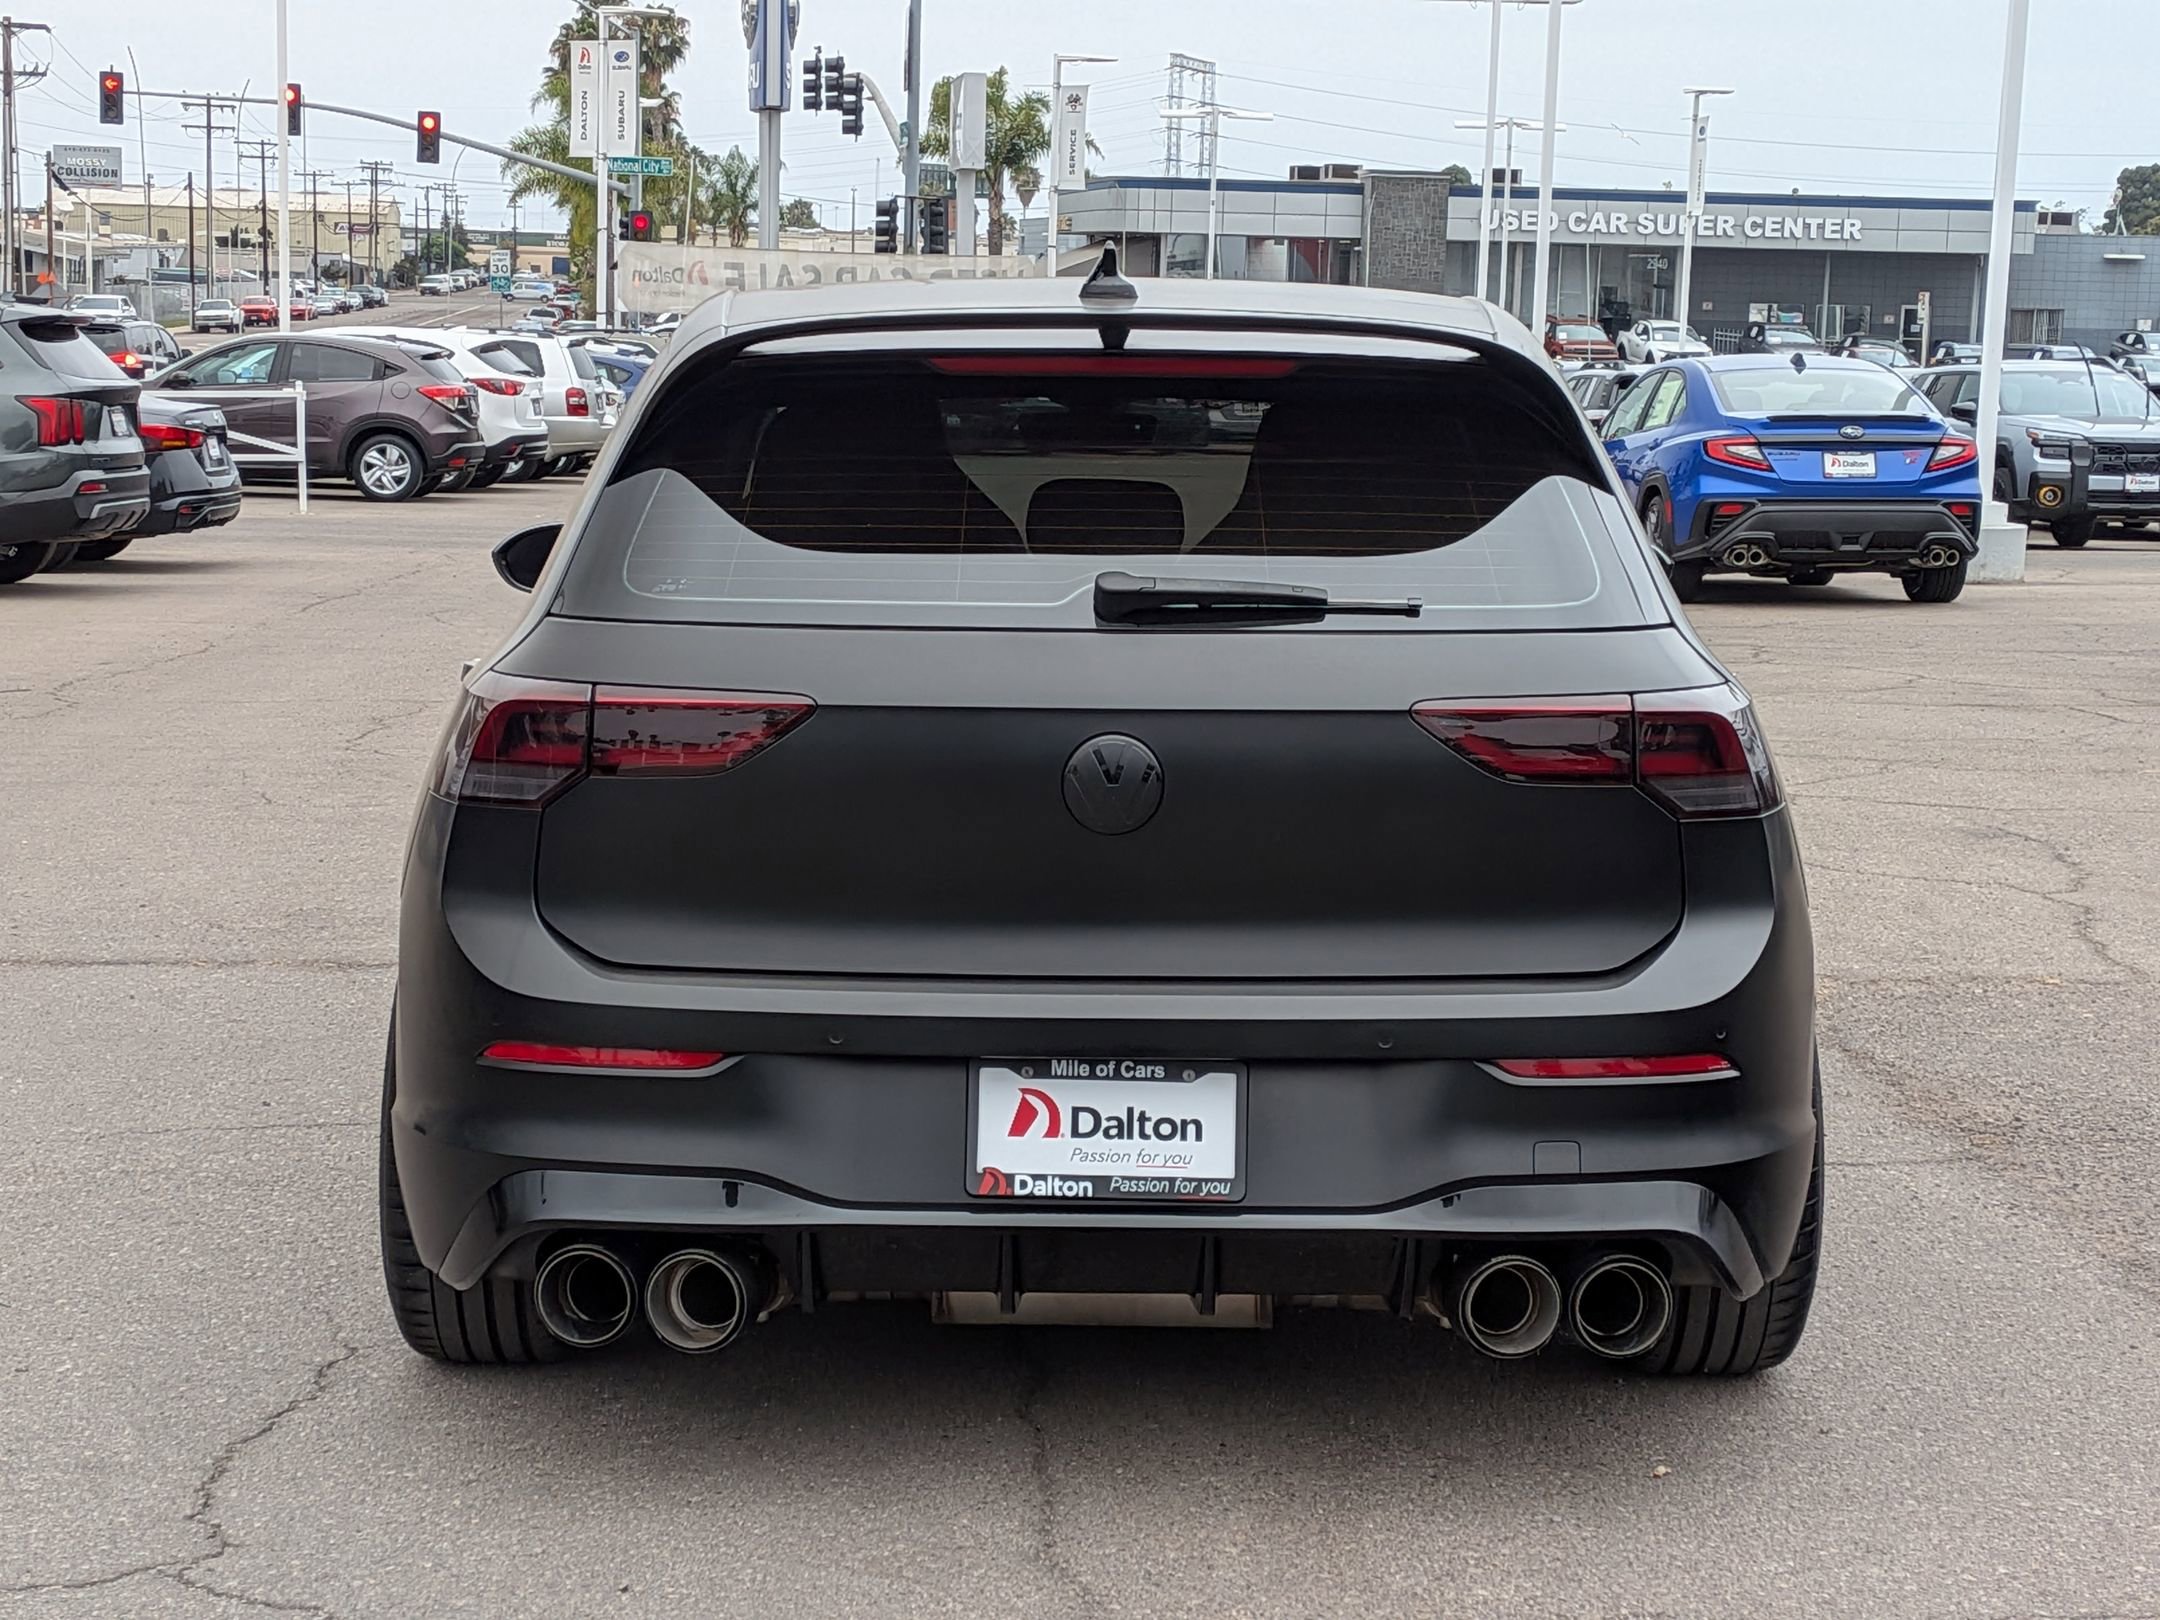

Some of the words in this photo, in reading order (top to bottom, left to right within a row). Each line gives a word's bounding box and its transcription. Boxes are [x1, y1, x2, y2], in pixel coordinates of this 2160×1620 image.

[580, 90, 588, 140] DALTON
[618, 90, 626, 140] SUBARU
[66, 157, 107, 167] MOSSY
[1069, 129, 1077, 175] SERVICE
[57, 166, 118, 178] COLLISION
[607, 159, 641, 172] National
[642, 159, 660, 173] City
[1568, 210, 1628, 234] CAR
[1636, 212, 1736, 238] SUPER
[1743, 215, 1863, 240] CENTER
[492, 264, 509, 274] 30
[1842, 459, 1870, 468] Dalton
[1051, 1059, 1090, 1077] Mile
[1095, 1060, 1115, 1077] of
[1120, 1061, 1166, 1079] Cars
[1070, 1105, 1204, 1142] Dalton
[1070, 1147, 1132, 1164] Passion
[1135, 1148, 1160, 1165] for
[1162, 1153, 1194, 1167] you
[1013, 1174, 1094, 1197] Dalton
[1109, 1176, 1170, 1194] Passion
[1173, 1177, 1199, 1194] for
[1200, 1180, 1231, 1196] you
